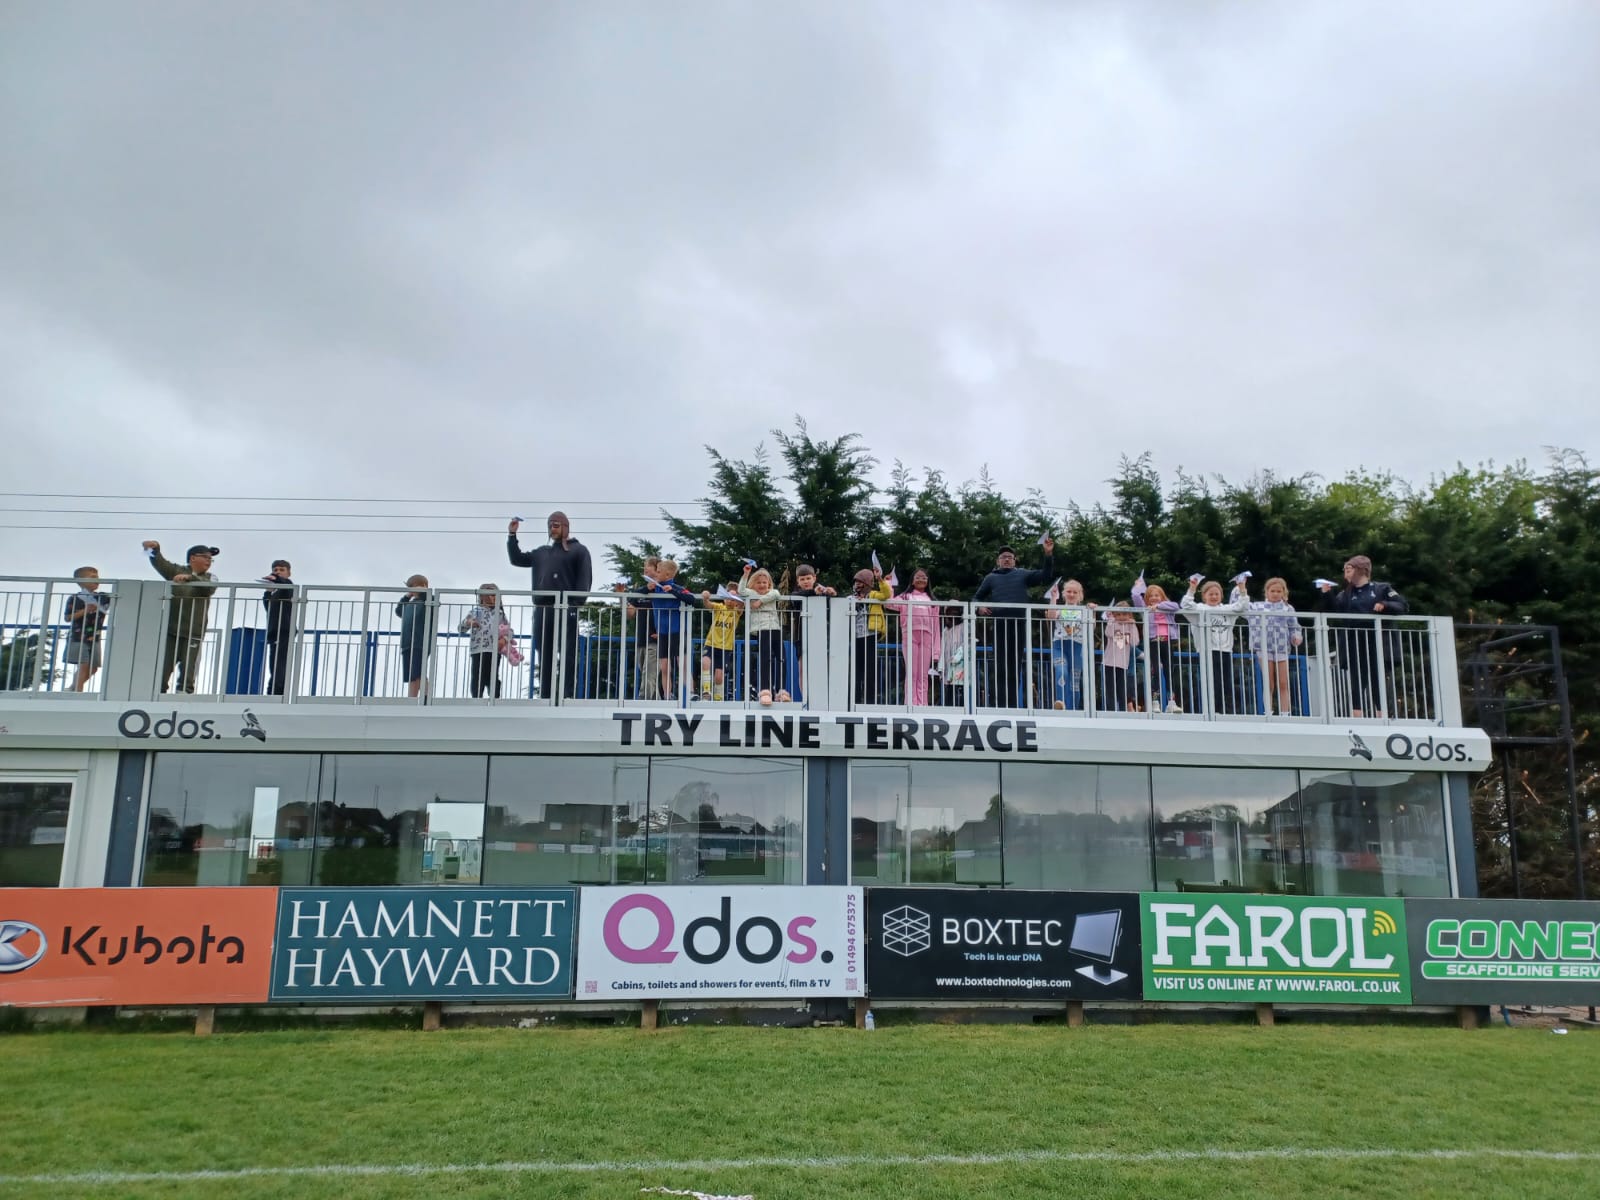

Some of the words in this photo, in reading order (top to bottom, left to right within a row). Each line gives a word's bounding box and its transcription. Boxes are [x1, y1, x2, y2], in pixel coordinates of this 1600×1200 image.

[118, 709, 222, 740] Qdos.
[613, 713, 704, 746] TRY
[720, 714, 821, 749] LINE
[836, 717, 1039, 752] TERRACE
[1385, 733, 1473, 762] Qdos.
[288, 899, 566, 939] HAMNETT
[602, 893, 835, 965] Qdos.
[847, 894, 857, 936] 675375
[942, 918, 1063, 946] BOXTEC
[61, 924, 245, 966] Kubota
[1150, 903, 1395, 969] FAROL
[1425, 919, 1600, 960] CONNE
[284, 947, 561, 987] HAYWARD
[847, 938, 857, 973] 01494
[964, 952, 986, 961] Tech
[987, 953, 995, 961] is
[996, 953, 1005, 961] in
[1022, 953, 1042, 962] DNA
[1446, 964, 1553, 976] SCAFFOLDING
[611, 981, 646, 991] Cabins,
[648, 980, 678, 990] toilets
[679, 980, 698, 989] and
[699, 979, 737, 989] showers
[739, 979, 753, 989] for
[754, 979, 788, 989] events,
[789, 978, 808, 988] film
[809, 979, 817, 988] &
[818, 978, 831, 988] TV
[935, 976, 1072, 989] www.boxtechnologies.com
[1153, 978, 1186, 990] VISIT
[1188, 977, 1205, 990] US
[1207, 978, 1255, 991] ONLINE
[1257, 980, 1273, 991] AT
[1275, 980, 1401, 993] WWW.FAROL.CO.UK
